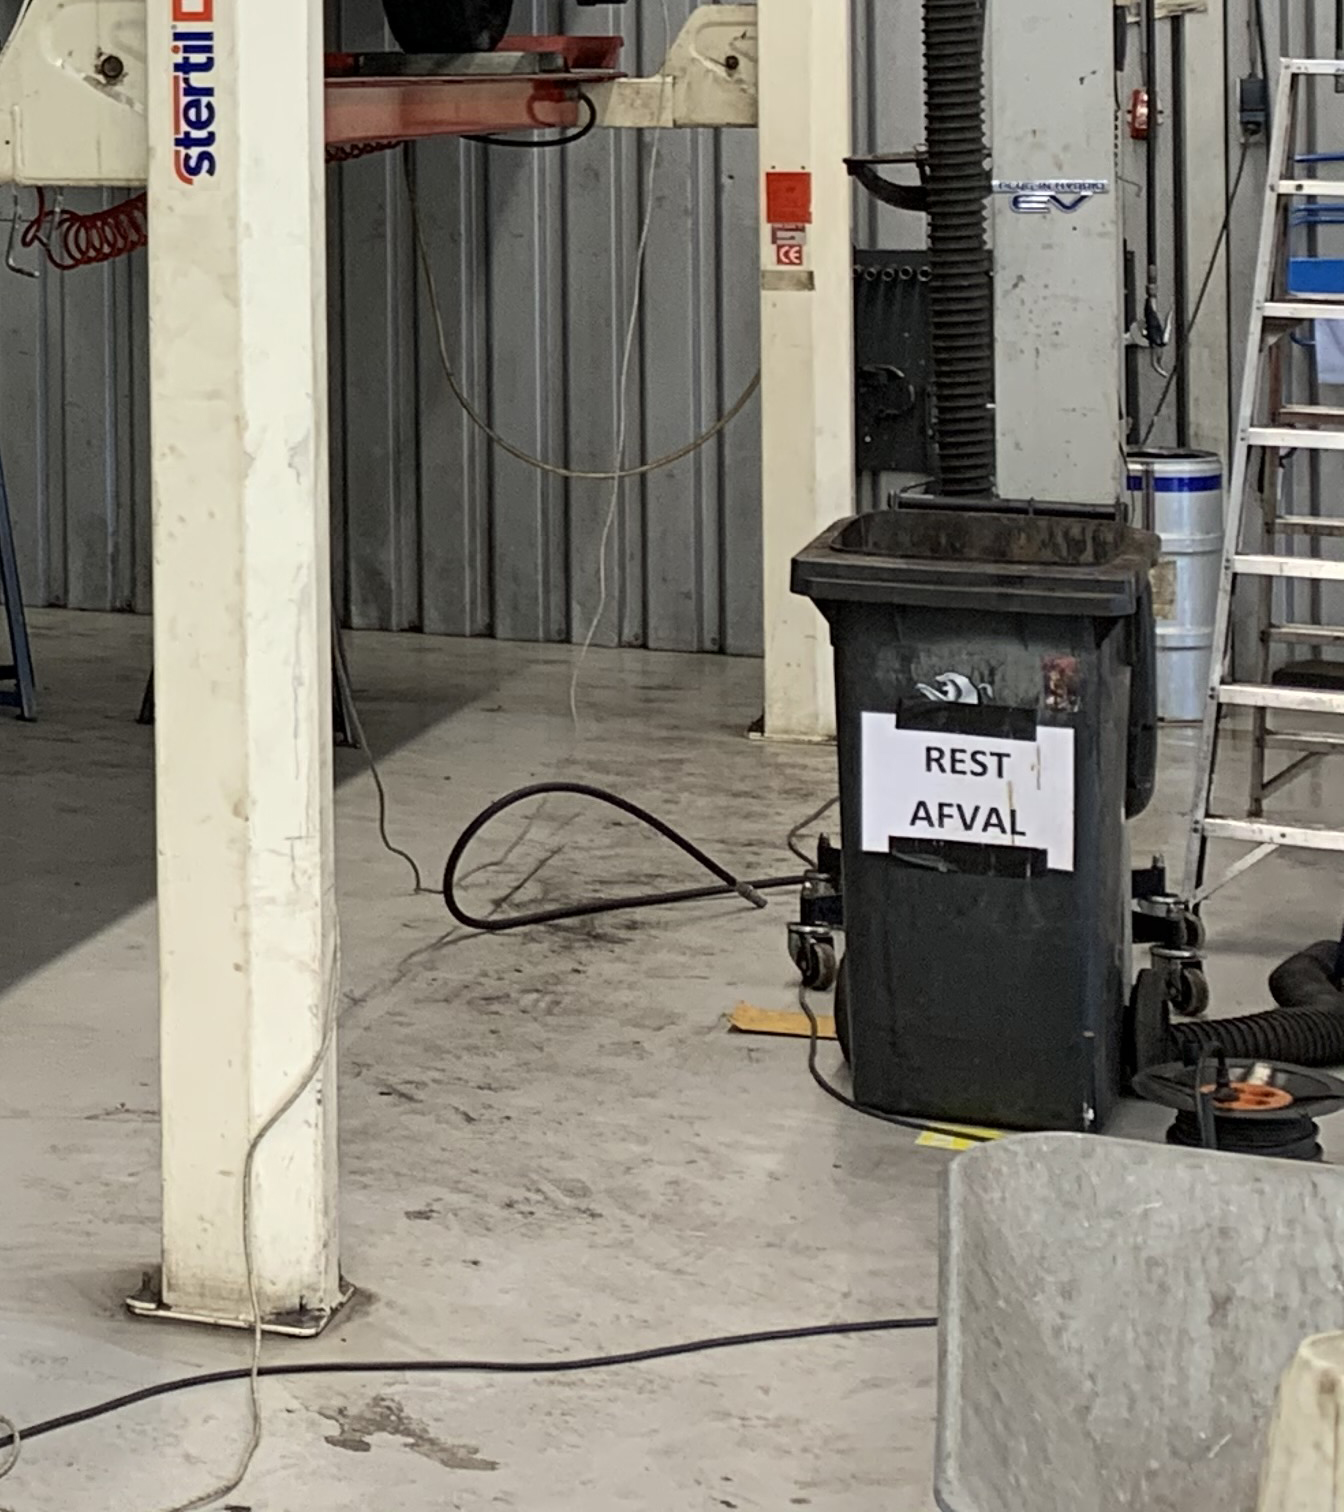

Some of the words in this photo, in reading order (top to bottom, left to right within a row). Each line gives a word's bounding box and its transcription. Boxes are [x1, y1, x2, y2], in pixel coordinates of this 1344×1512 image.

[172, 31, 216, 178] stertil
[925, 745, 1012, 779] REST
[909, 800, 1027, 837] AFVAL
